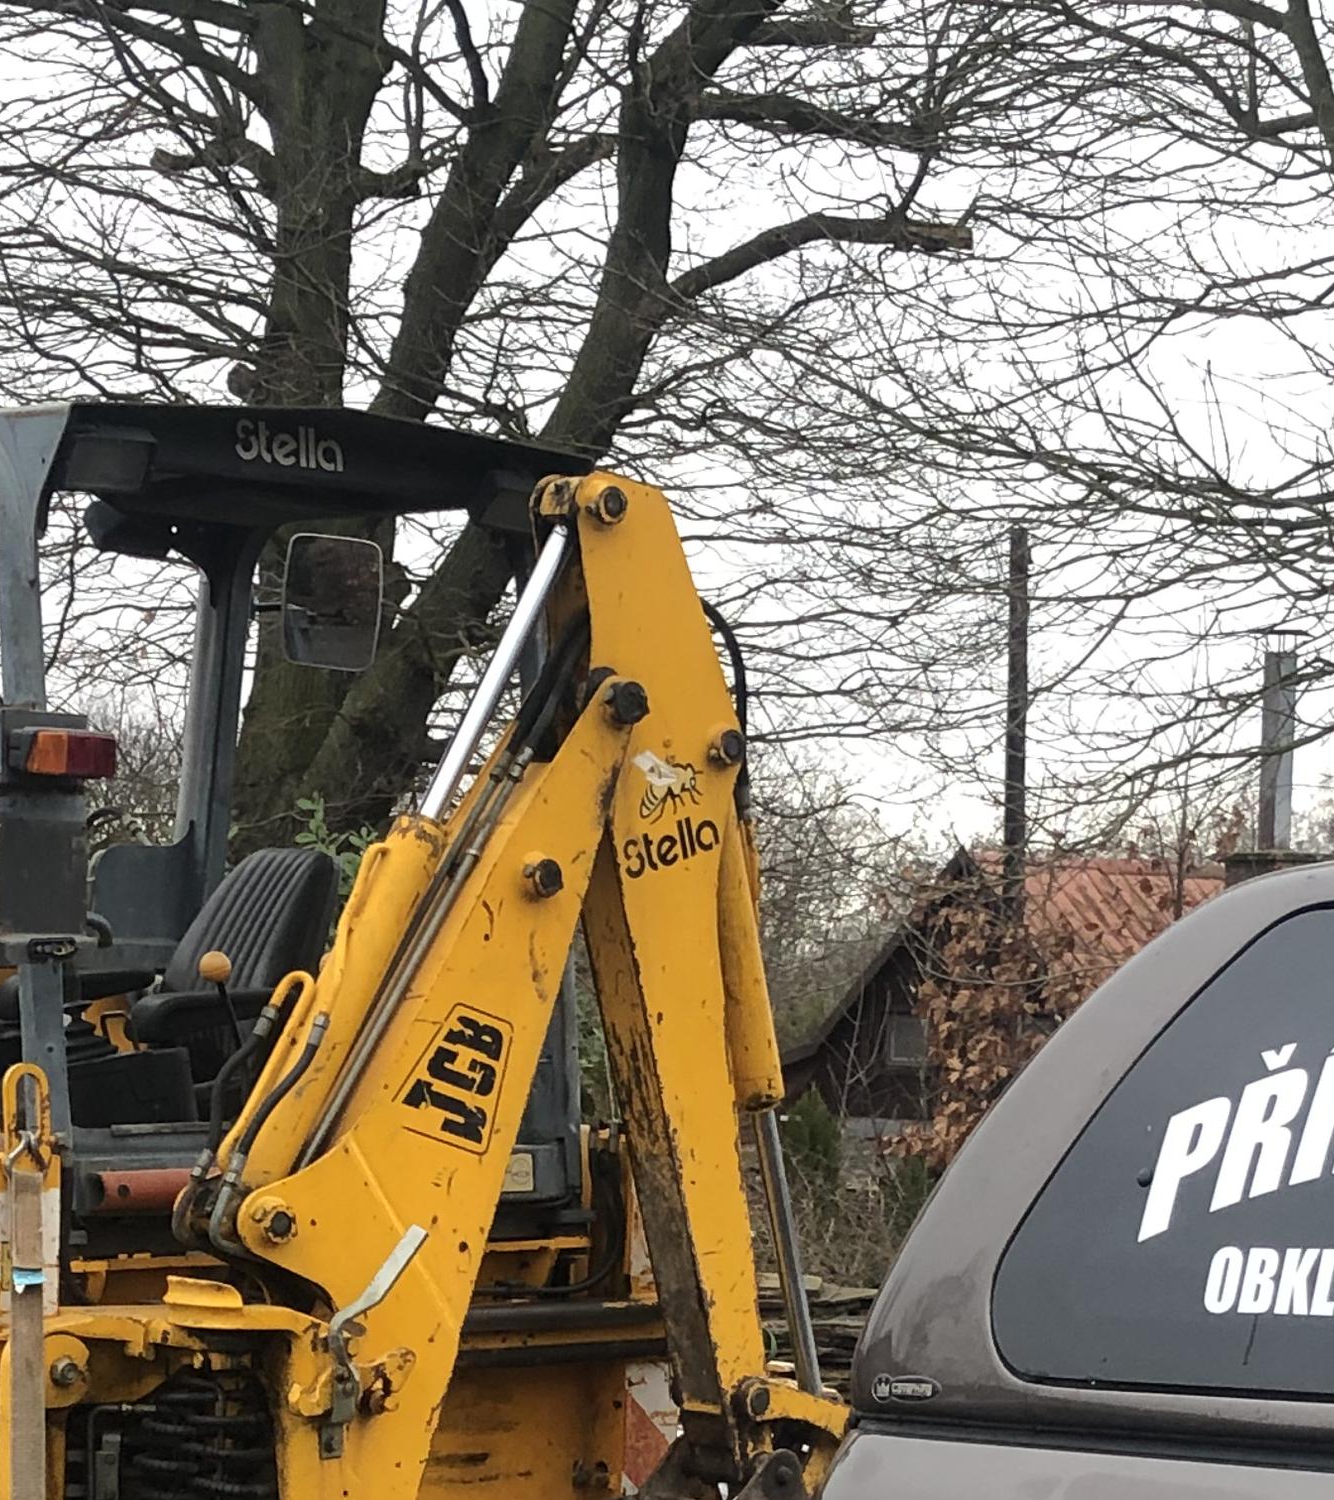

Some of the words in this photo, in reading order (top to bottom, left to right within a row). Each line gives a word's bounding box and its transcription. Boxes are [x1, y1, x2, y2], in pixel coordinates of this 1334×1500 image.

[234, 418, 344, 472] Stella
[623, 816, 720, 879] Stella
[402, 1015, 504, 1145] JCB
